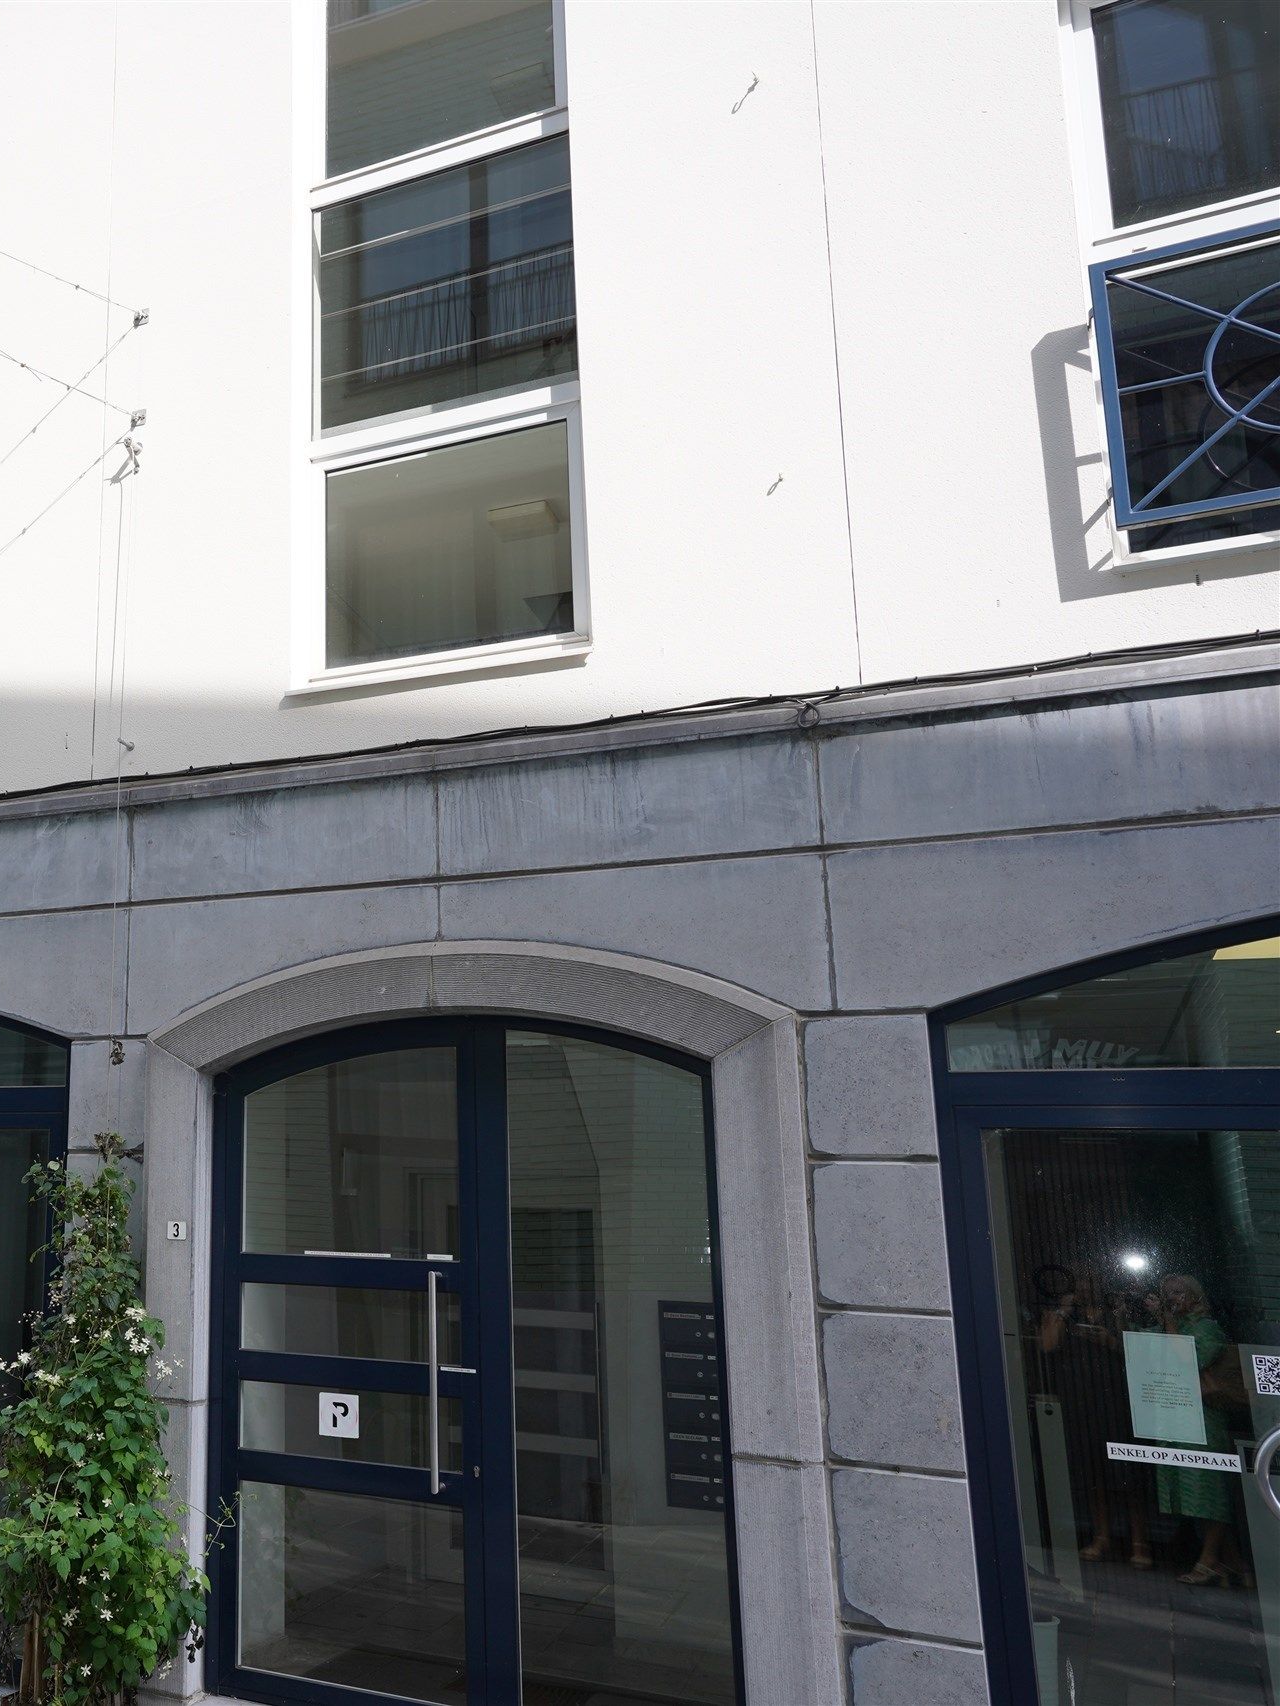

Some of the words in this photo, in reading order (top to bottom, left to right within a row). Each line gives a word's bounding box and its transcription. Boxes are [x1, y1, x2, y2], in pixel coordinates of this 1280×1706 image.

[173, 1222, 180, 1238] 3
[1110, 1446, 1149, 1459] ENKEL
[1152, 1451, 1168, 1460] OP
[1171, 1453, 1238, 1468] AFSPRAAK
